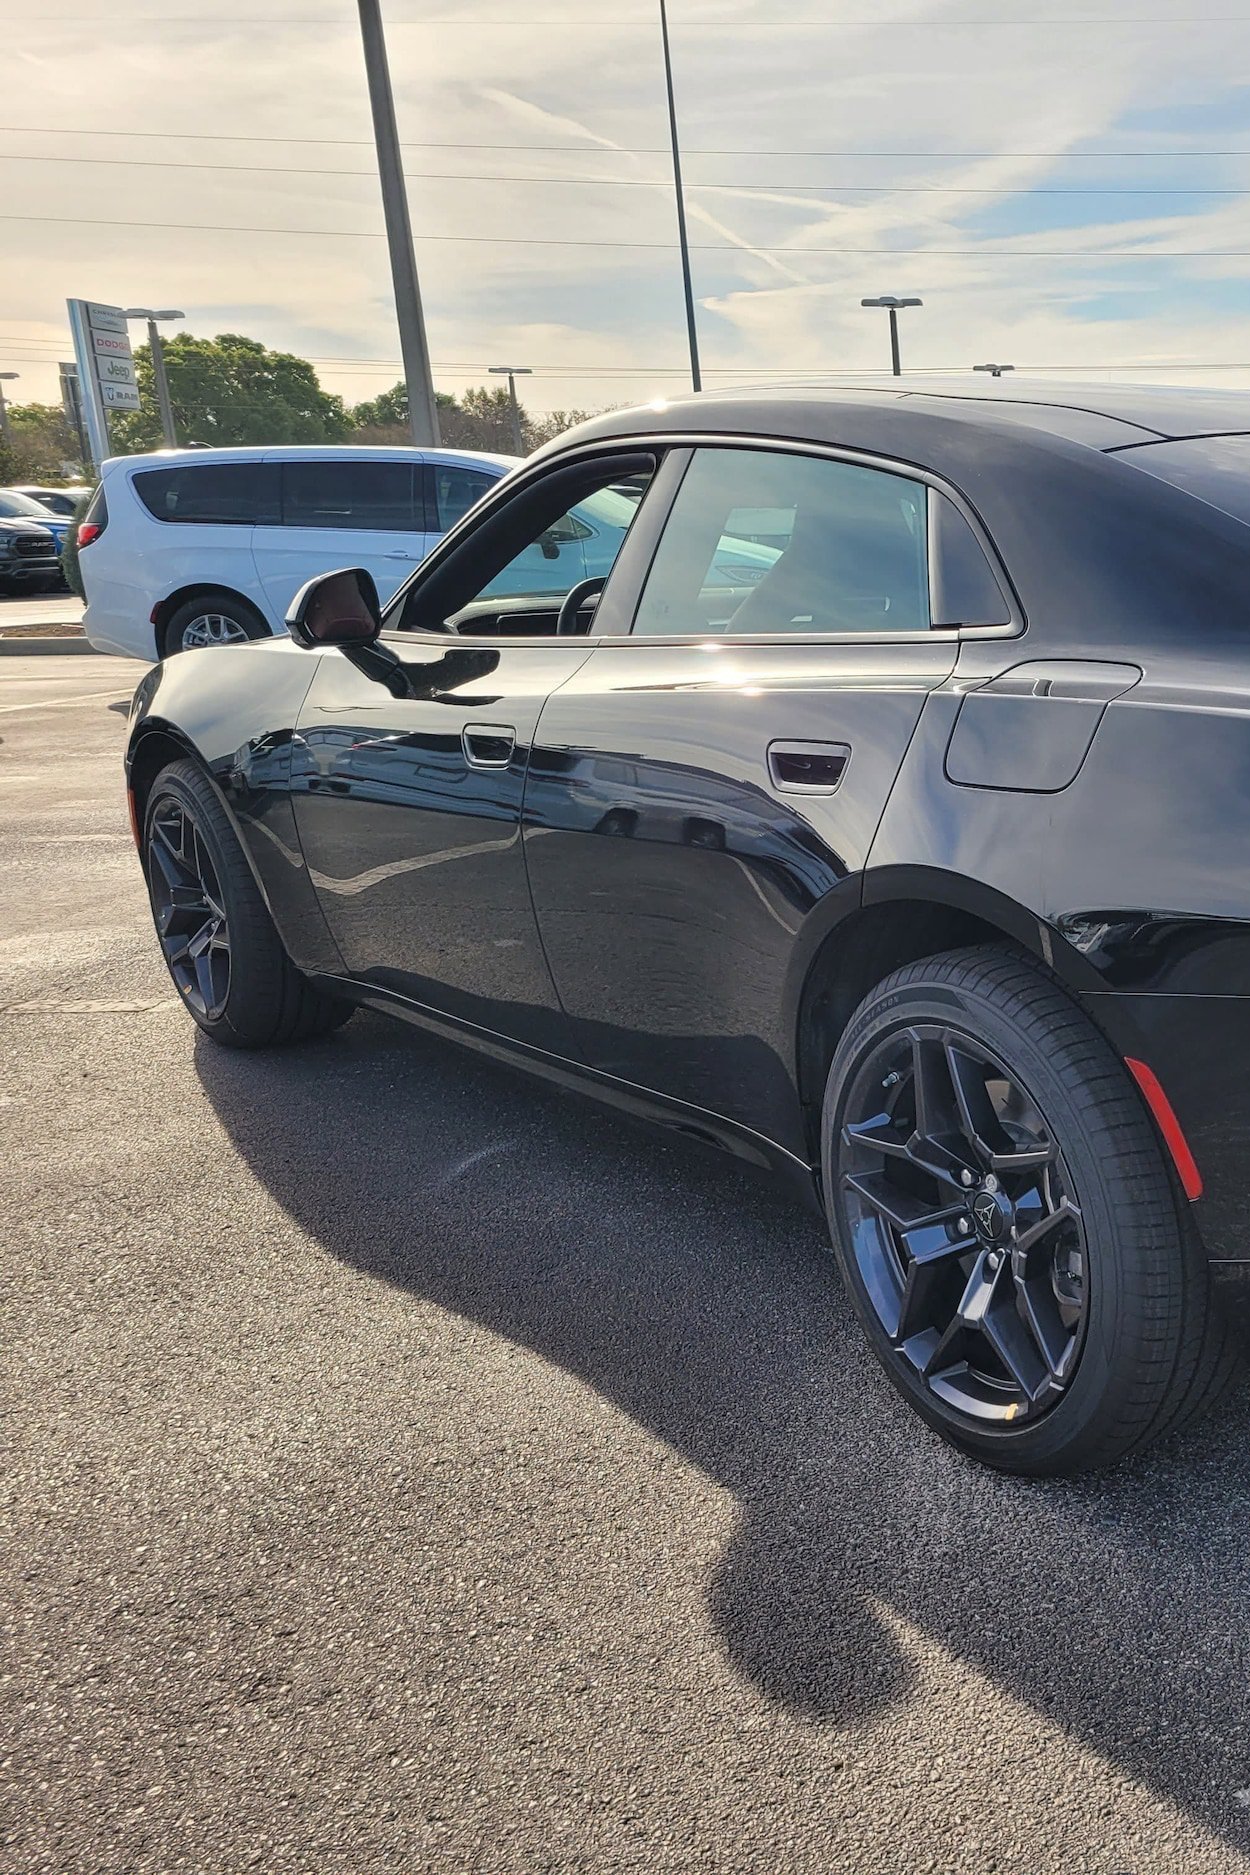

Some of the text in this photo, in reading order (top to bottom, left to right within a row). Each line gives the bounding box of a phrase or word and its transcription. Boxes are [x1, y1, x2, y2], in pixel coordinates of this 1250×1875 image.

[96, 338, 130, 350] DODGE
[107, 360, 130, 380] Jeep
[117, 391, 138, 401] RAM
